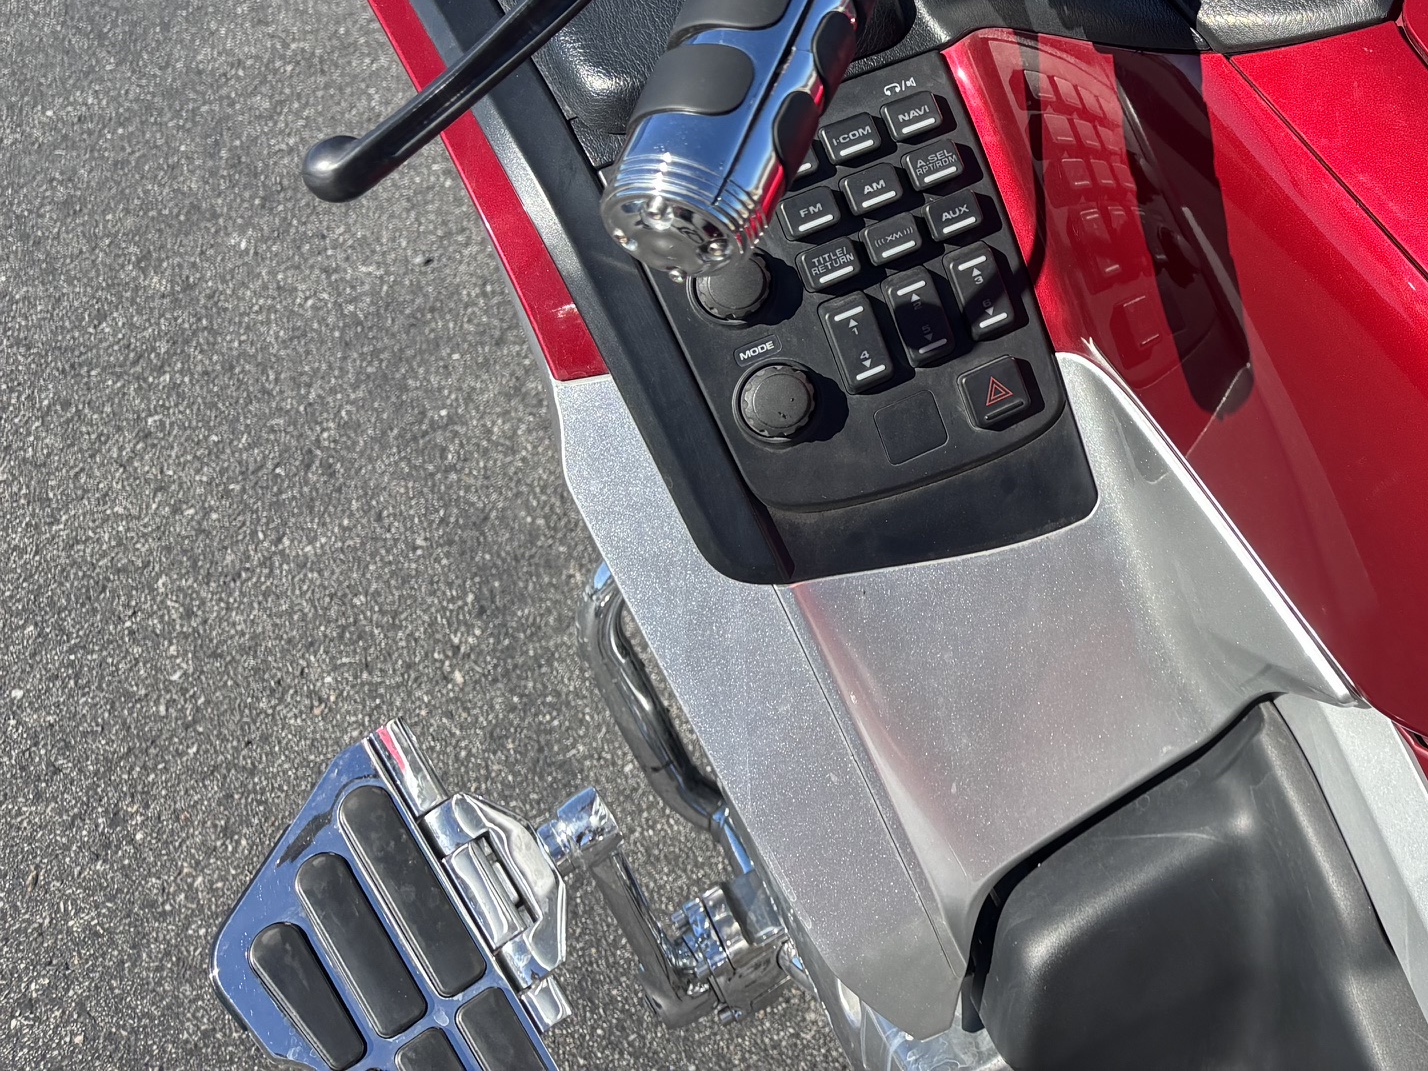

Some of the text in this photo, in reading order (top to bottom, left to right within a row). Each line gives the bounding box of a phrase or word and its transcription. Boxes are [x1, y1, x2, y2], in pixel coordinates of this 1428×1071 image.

[898, 105, 930, 122] NAVI
[916, 149, 953, 167] A.SEL
[916, 154, 958, 176] RPT/RDM
[863, 179, 886, 195] AM
[799, 202, 823, 218] FM
[941, 203, 969, 222] AUX
[811, 246, 847, 267] TITLE/
[811, 253, 855, 276] RETURN
[973, 275, 984, 285] 3
[912, 301, 922, 310] 2
[982, 299, 992, 307] 6
[851, 328, 859, 336] 1
[739, 340, 775, 361] MODE
[859, 350, 870, 359] 4
